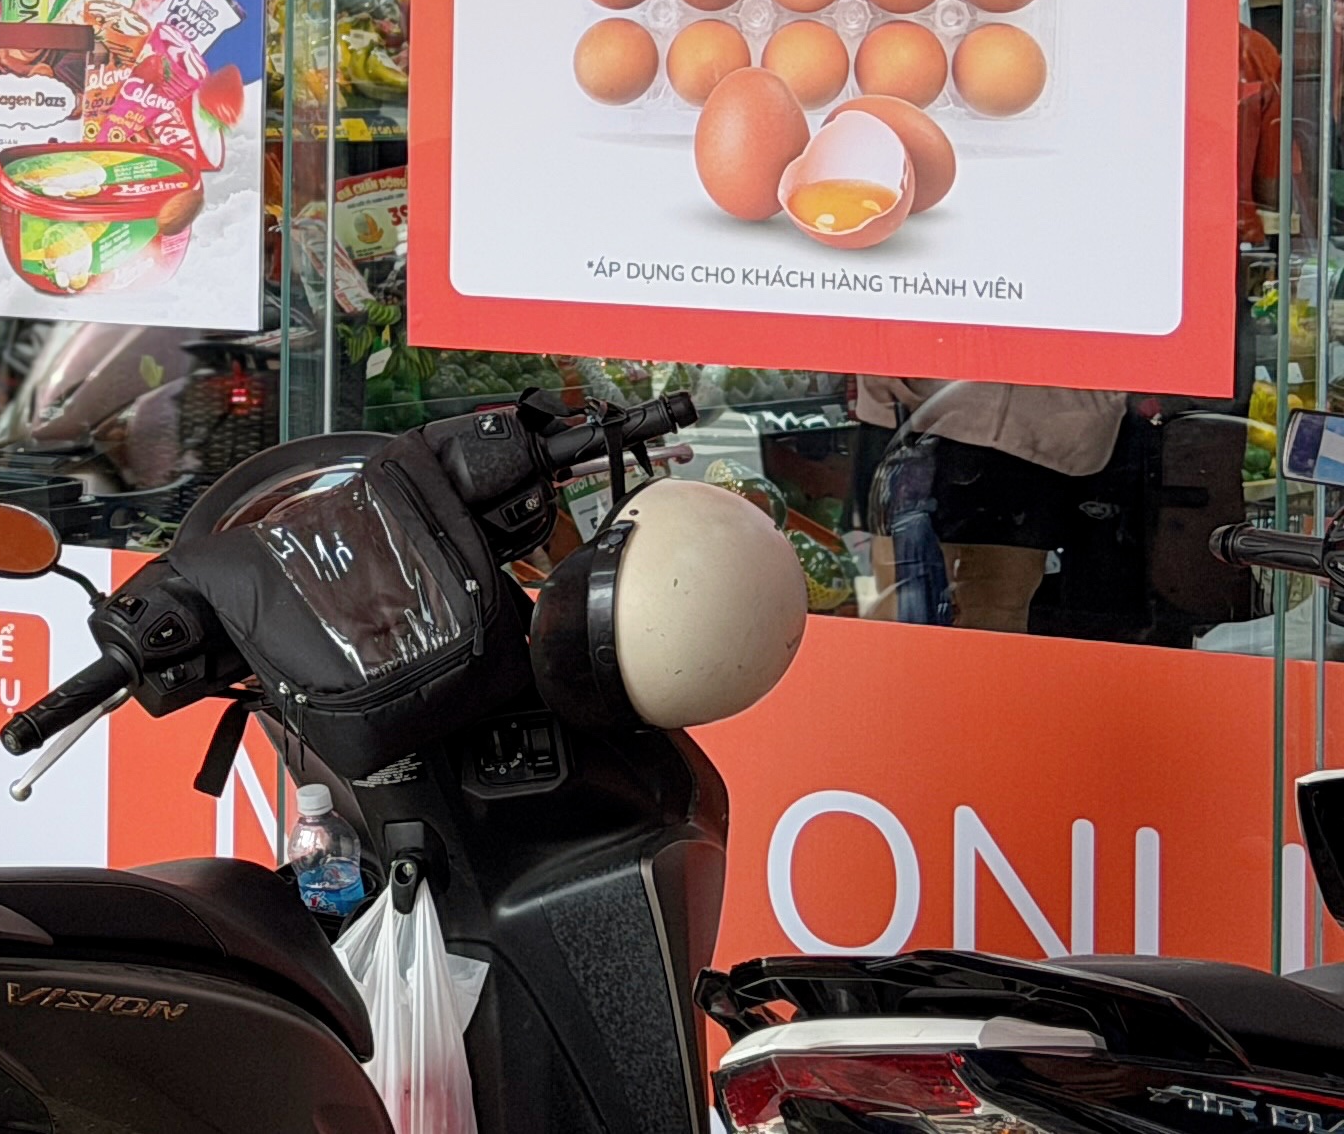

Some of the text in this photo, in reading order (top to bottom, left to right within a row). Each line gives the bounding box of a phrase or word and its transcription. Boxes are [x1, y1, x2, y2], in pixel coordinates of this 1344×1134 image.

[627, 263, 1024, 301] DỤNG CHO KHÁCH HÀNG THÀNH VIÊN
[6, 981, 188, 1021] VISION
